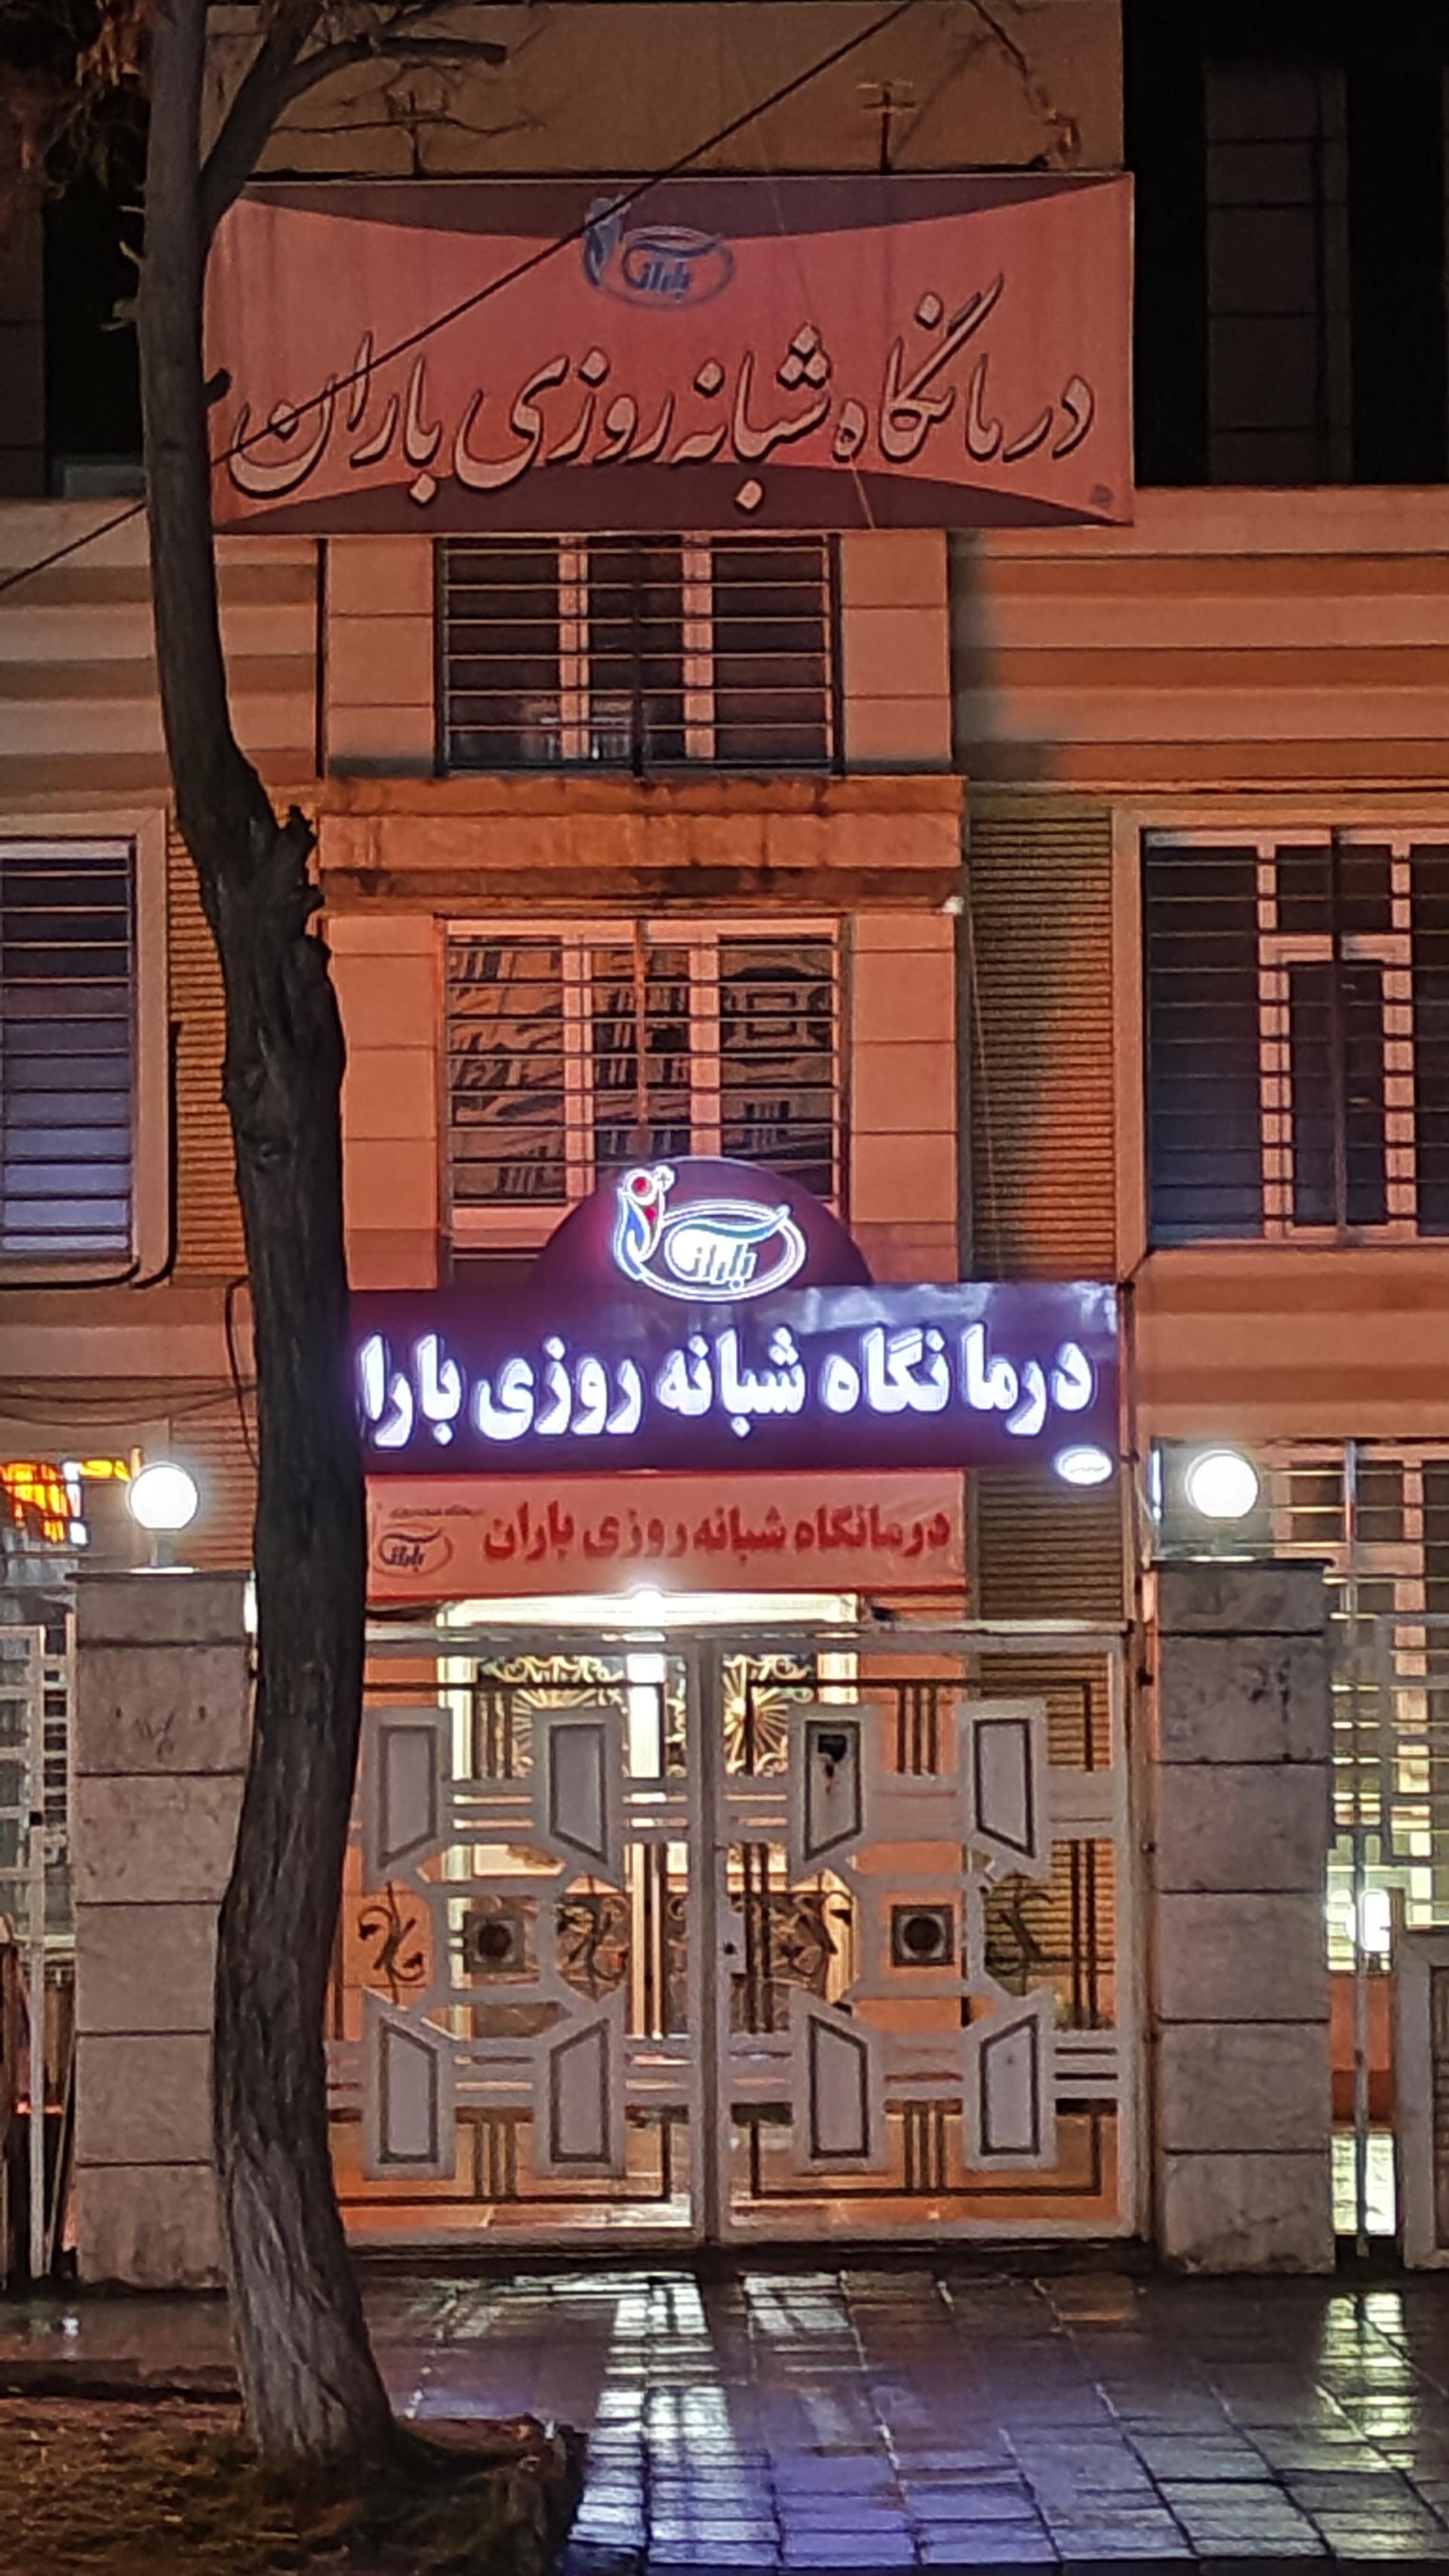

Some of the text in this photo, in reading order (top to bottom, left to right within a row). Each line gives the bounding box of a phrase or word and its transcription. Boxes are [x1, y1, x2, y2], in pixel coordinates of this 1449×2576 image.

[227, 330, 442, 507] باران
[832, 272, 1094, 463] درمانگاه
[359, 1323, 1094, 1449] درمانگاه شبانه روزی بارا
[484, 1500, 574, 1563] باران
[795, 1504, 952, 1558] درمانگاه
